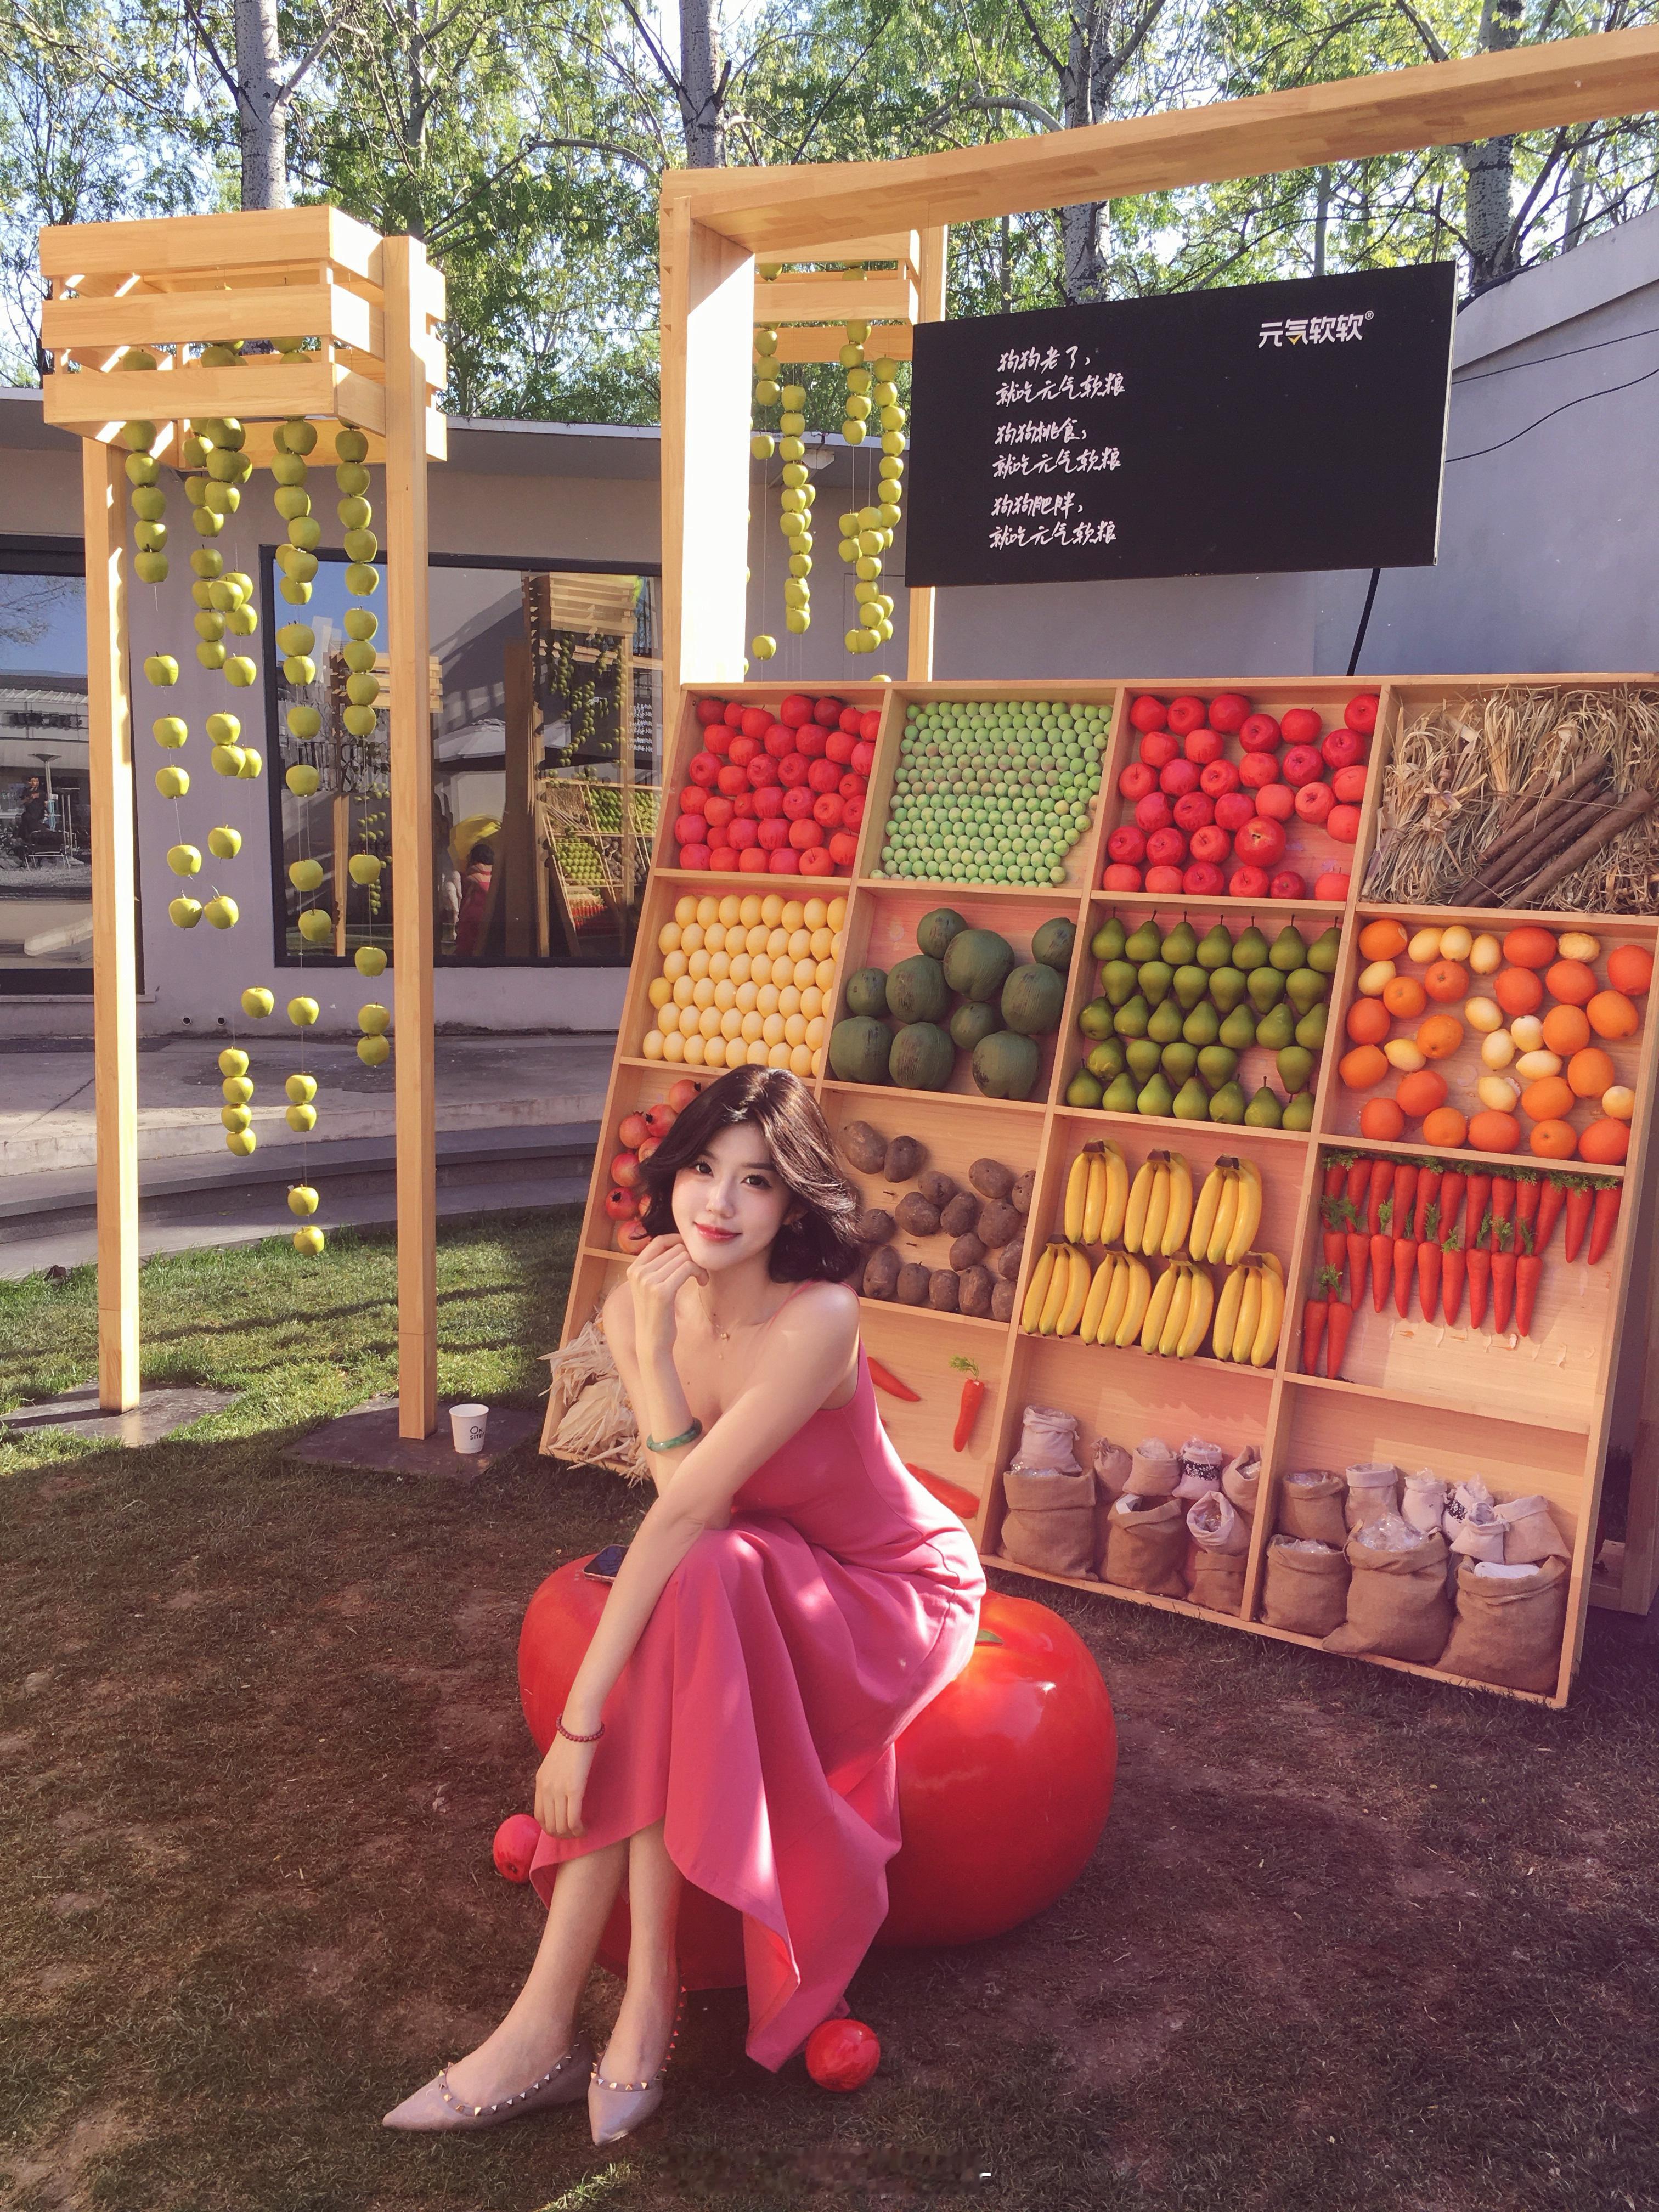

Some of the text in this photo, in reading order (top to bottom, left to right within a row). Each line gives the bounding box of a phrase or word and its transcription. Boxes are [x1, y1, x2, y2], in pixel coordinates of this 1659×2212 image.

[1258, 313, 1364, 348] 元气软软
[997, 346, 1090, 374] 狗狗老了,
[995, 372, 1125, 407] 就吃元气软粮
[992, 447, 1121, 479] 就吃元气软粮
[989, 520, 1116, 550] 就吃元气软粮
